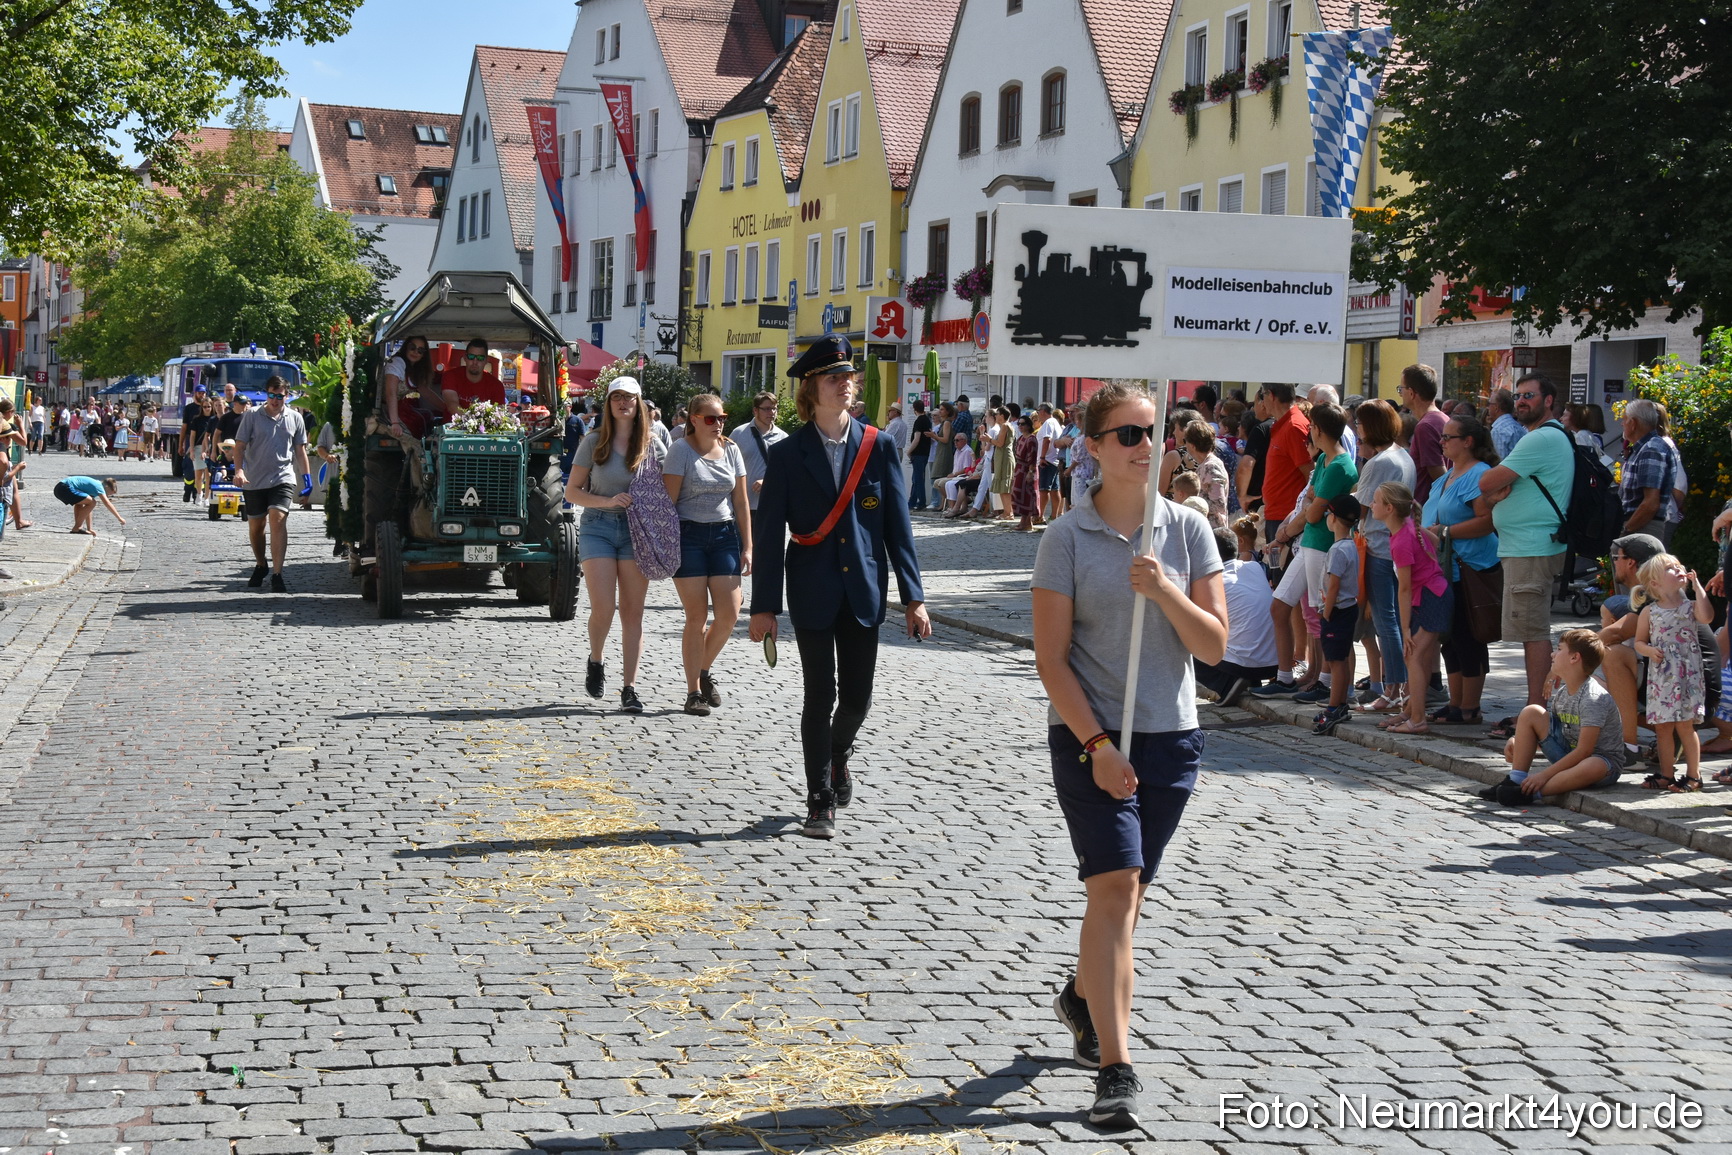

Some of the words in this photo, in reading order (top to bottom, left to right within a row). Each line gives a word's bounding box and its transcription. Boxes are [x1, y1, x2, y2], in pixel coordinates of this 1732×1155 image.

[622, 90, 631, 134] RUPPERT
[732, 213, 758, 238] HOTEL
[763, 210, 793, 231] Lehmeier
[1171, 276, 1333, 296] Modelleisenbahnclub
[1350, 295, 1373, 310] RIALTO
[1375, 292, 1391, 308] KINO
[760, 318, 789, 326] TAIFUN
[825, 308, 832, 332] P
[1173, 316, 1251, 331] Neumarkt
[1255, 319, 1263, 334] /
[1267, 320, 1299, 336] Opf.
[1303, 322, 1332, 335] e.V.
[726, 328, 762, 345] Restaurant
[447, 443, 518, 453] HANOMAG
[467, 553, 480, 562] SX
[483, 553, 494, 562] 39
[474, 546, 488, 554] NM
